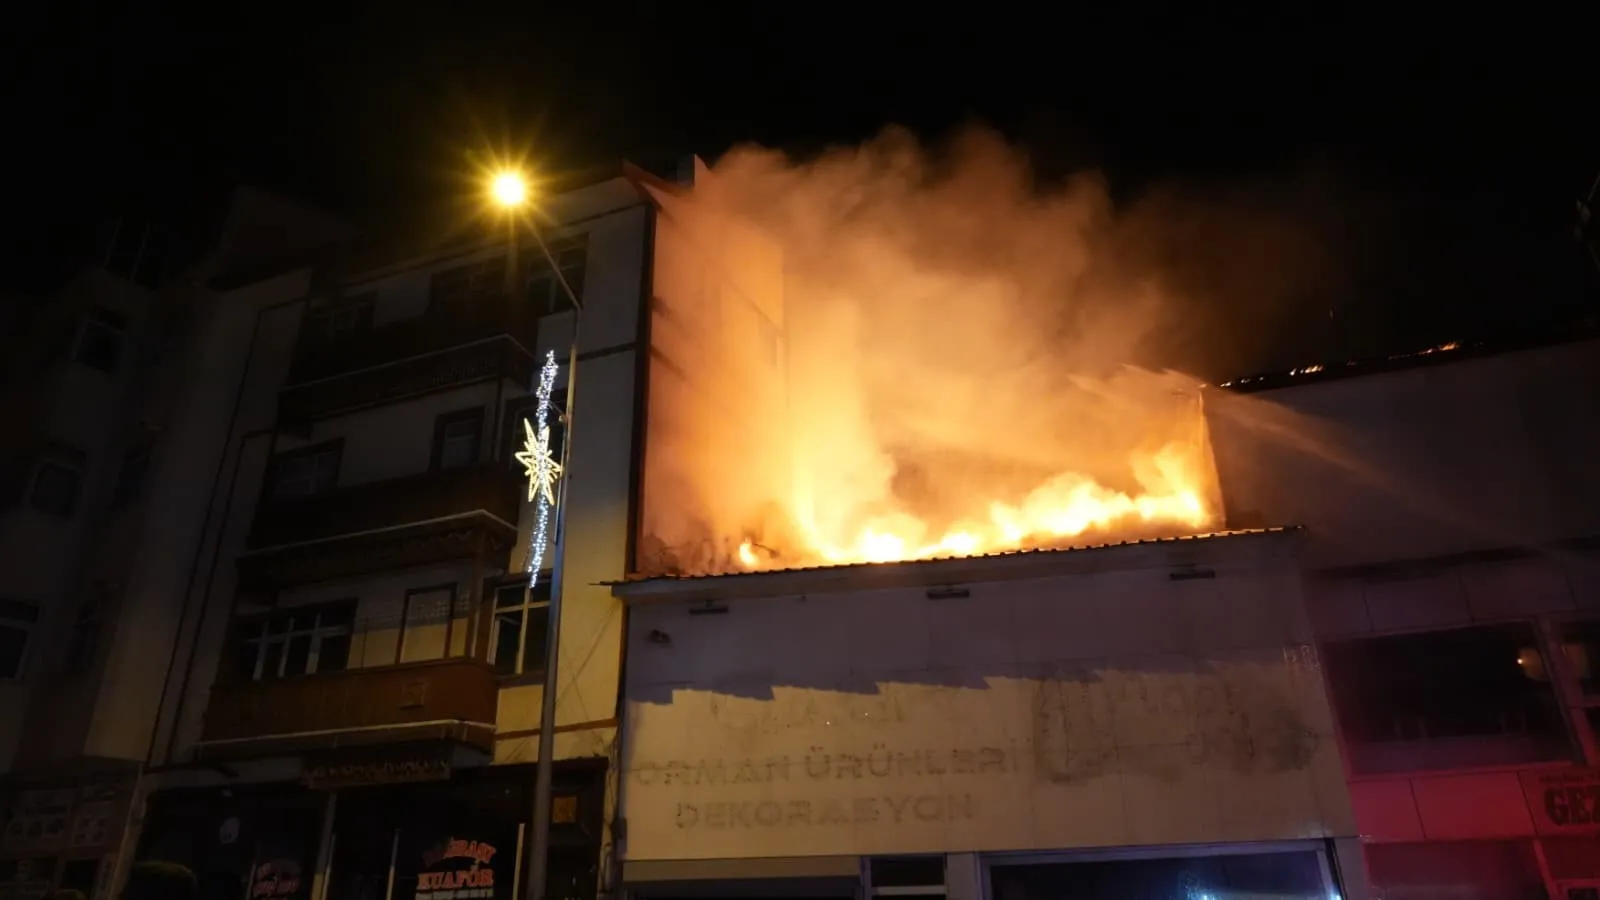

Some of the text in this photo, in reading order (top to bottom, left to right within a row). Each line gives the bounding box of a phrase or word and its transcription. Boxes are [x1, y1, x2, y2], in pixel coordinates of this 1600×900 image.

[634, 754, 791, 786] ORMAN
[675, 793, 976, 830] DEKORASYON
[415, 864, 495, 890] KUAFÖR
